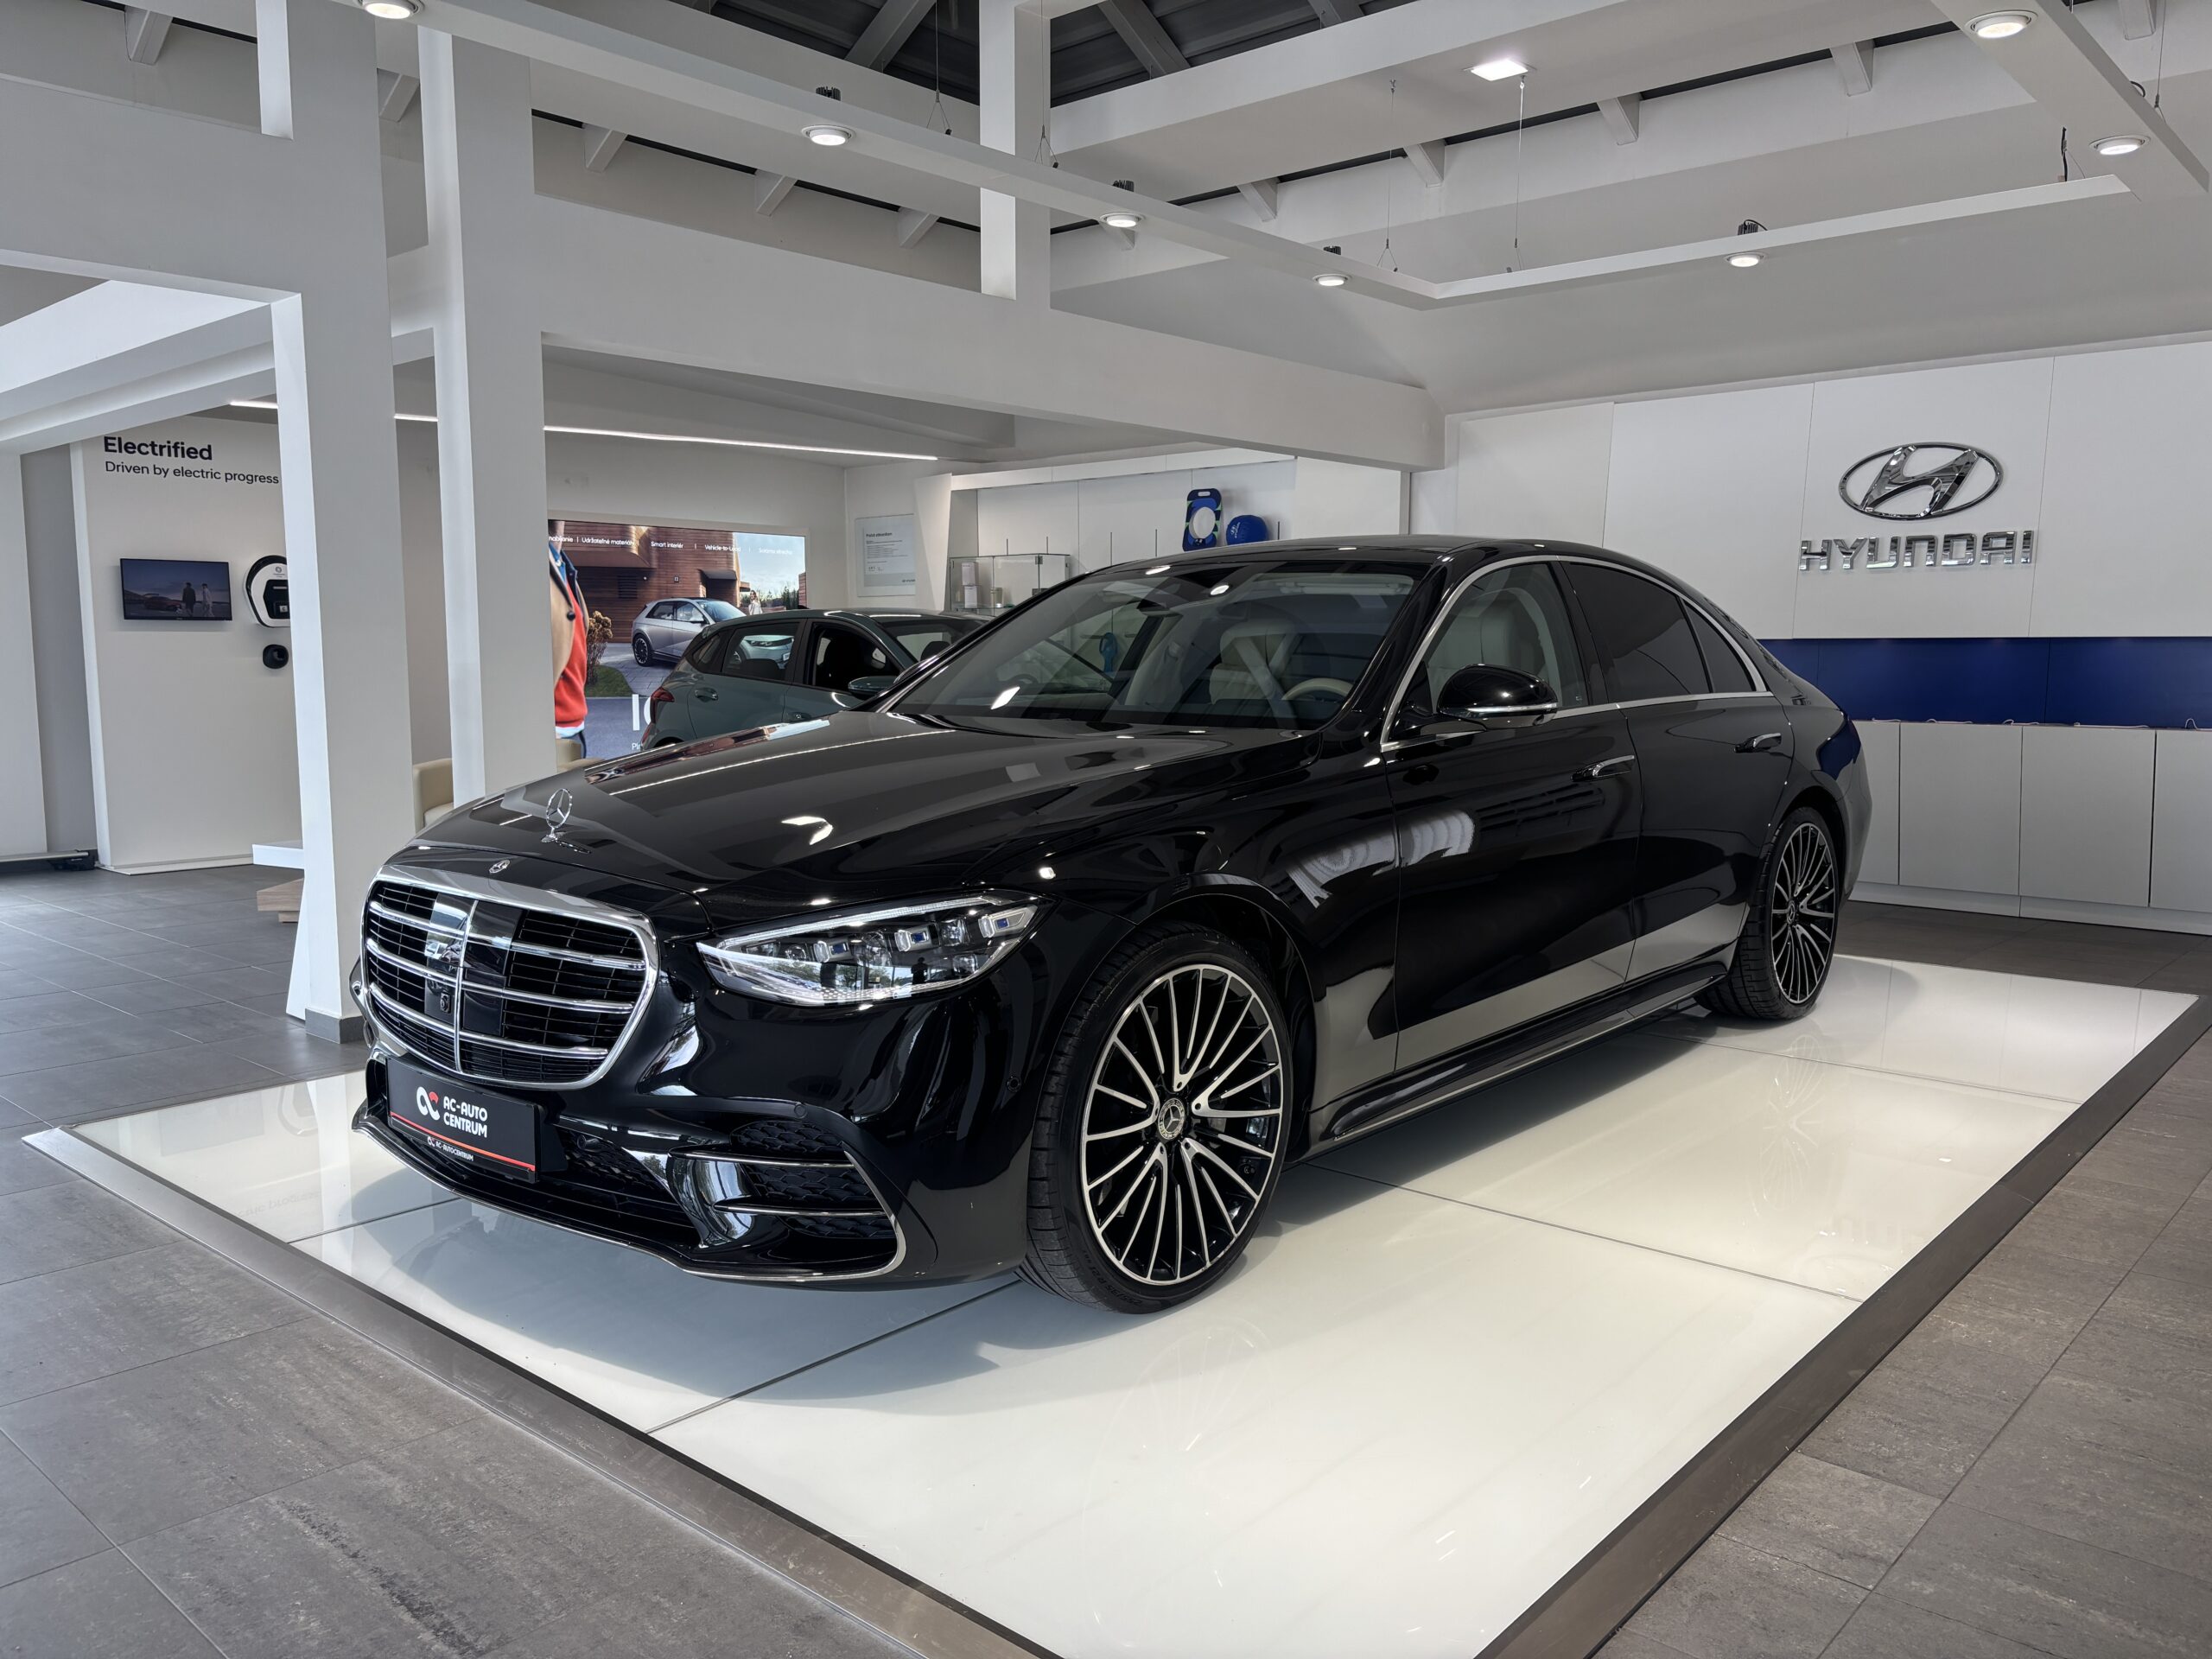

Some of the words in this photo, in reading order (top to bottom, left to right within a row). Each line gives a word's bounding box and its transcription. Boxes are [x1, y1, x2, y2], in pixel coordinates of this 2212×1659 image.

[104, 436, 213, 460] Electrified
[105, 461, 149, 474] Driven
[153, 464, 169, 478] by
[173, 467, 221, 480] electric
[225, 471, 279, 484] progress
[1799, 531, 2034, 570] HYUNDAI
[443, 1096, 488, 1122] AC-AUTO
[443, 1112, 488, 1139] CENTRUM
